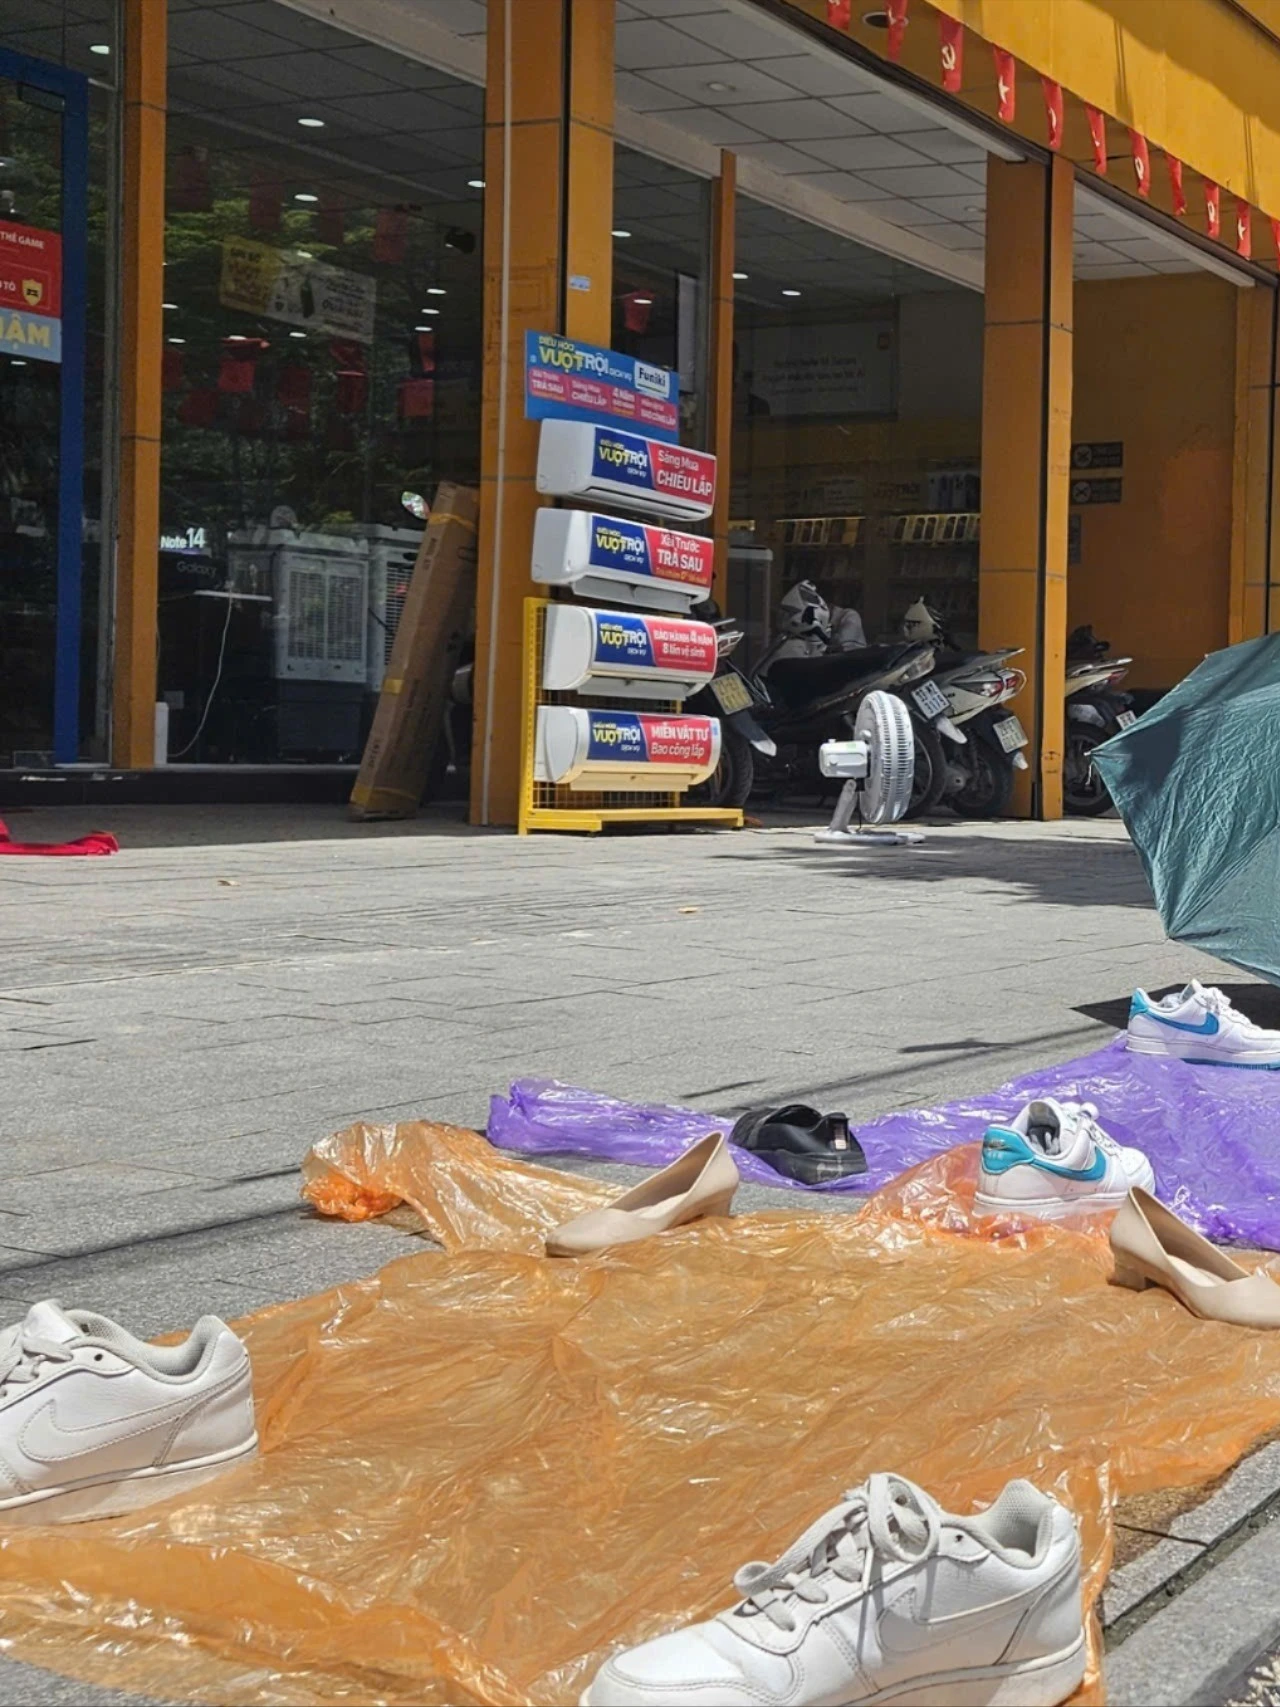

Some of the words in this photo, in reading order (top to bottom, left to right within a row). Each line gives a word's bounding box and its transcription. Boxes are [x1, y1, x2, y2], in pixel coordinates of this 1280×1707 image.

[18, 235, 45, 250] GAME
[0, 309, 50, 349] ẬM
[639, 367, 666, 387] Funiki
[658, 449, 681, 469] Sáng
[681, 456, 699, 472] Mua
[692, 474, 713, 496] LẮP
[160, 535, 187, 549] Note
[186, 527, 207, 549] 14
[656, 547, 680, 568] TRẢ
[680, 553, 704, 573] SAU
[690, 629, 698, 644] 4
[662, 642, 669, 655] 8
[690, 645, 706, 658] sinh
[650, 721, 676, 740] MIỄN
[677, 724, 695, 744] VẬT
[694, 727, 710, 742] TƯ
[651, 742, 668, 756] Bao
[669, 742, 691, 759] công
[691, 743, 705, 759] lắp
